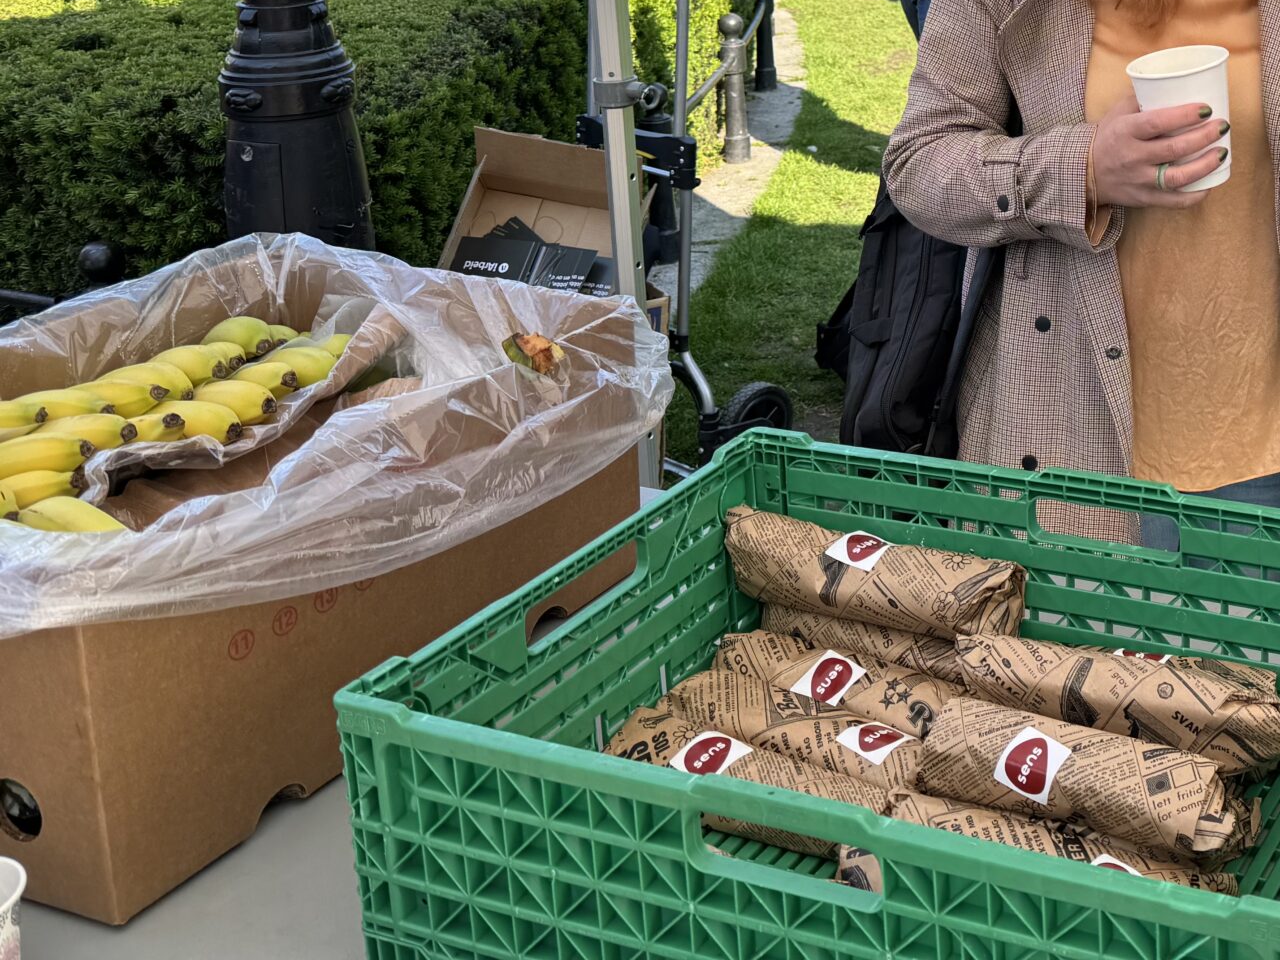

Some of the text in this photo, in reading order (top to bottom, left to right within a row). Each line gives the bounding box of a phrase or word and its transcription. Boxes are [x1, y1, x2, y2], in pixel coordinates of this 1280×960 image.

[463, 260, 498, 273] iArbeid
[274, 608, 296, 633] 12
[230, 631, 252, 657] 11
[816, 663, 844, 695] sens
[1108, 683, 1120, 700] lin
[1171, 709, 1202, 737] SVAN
[693, 741, 726, 769] sens
[1016, 745, 1043, 786] sens
